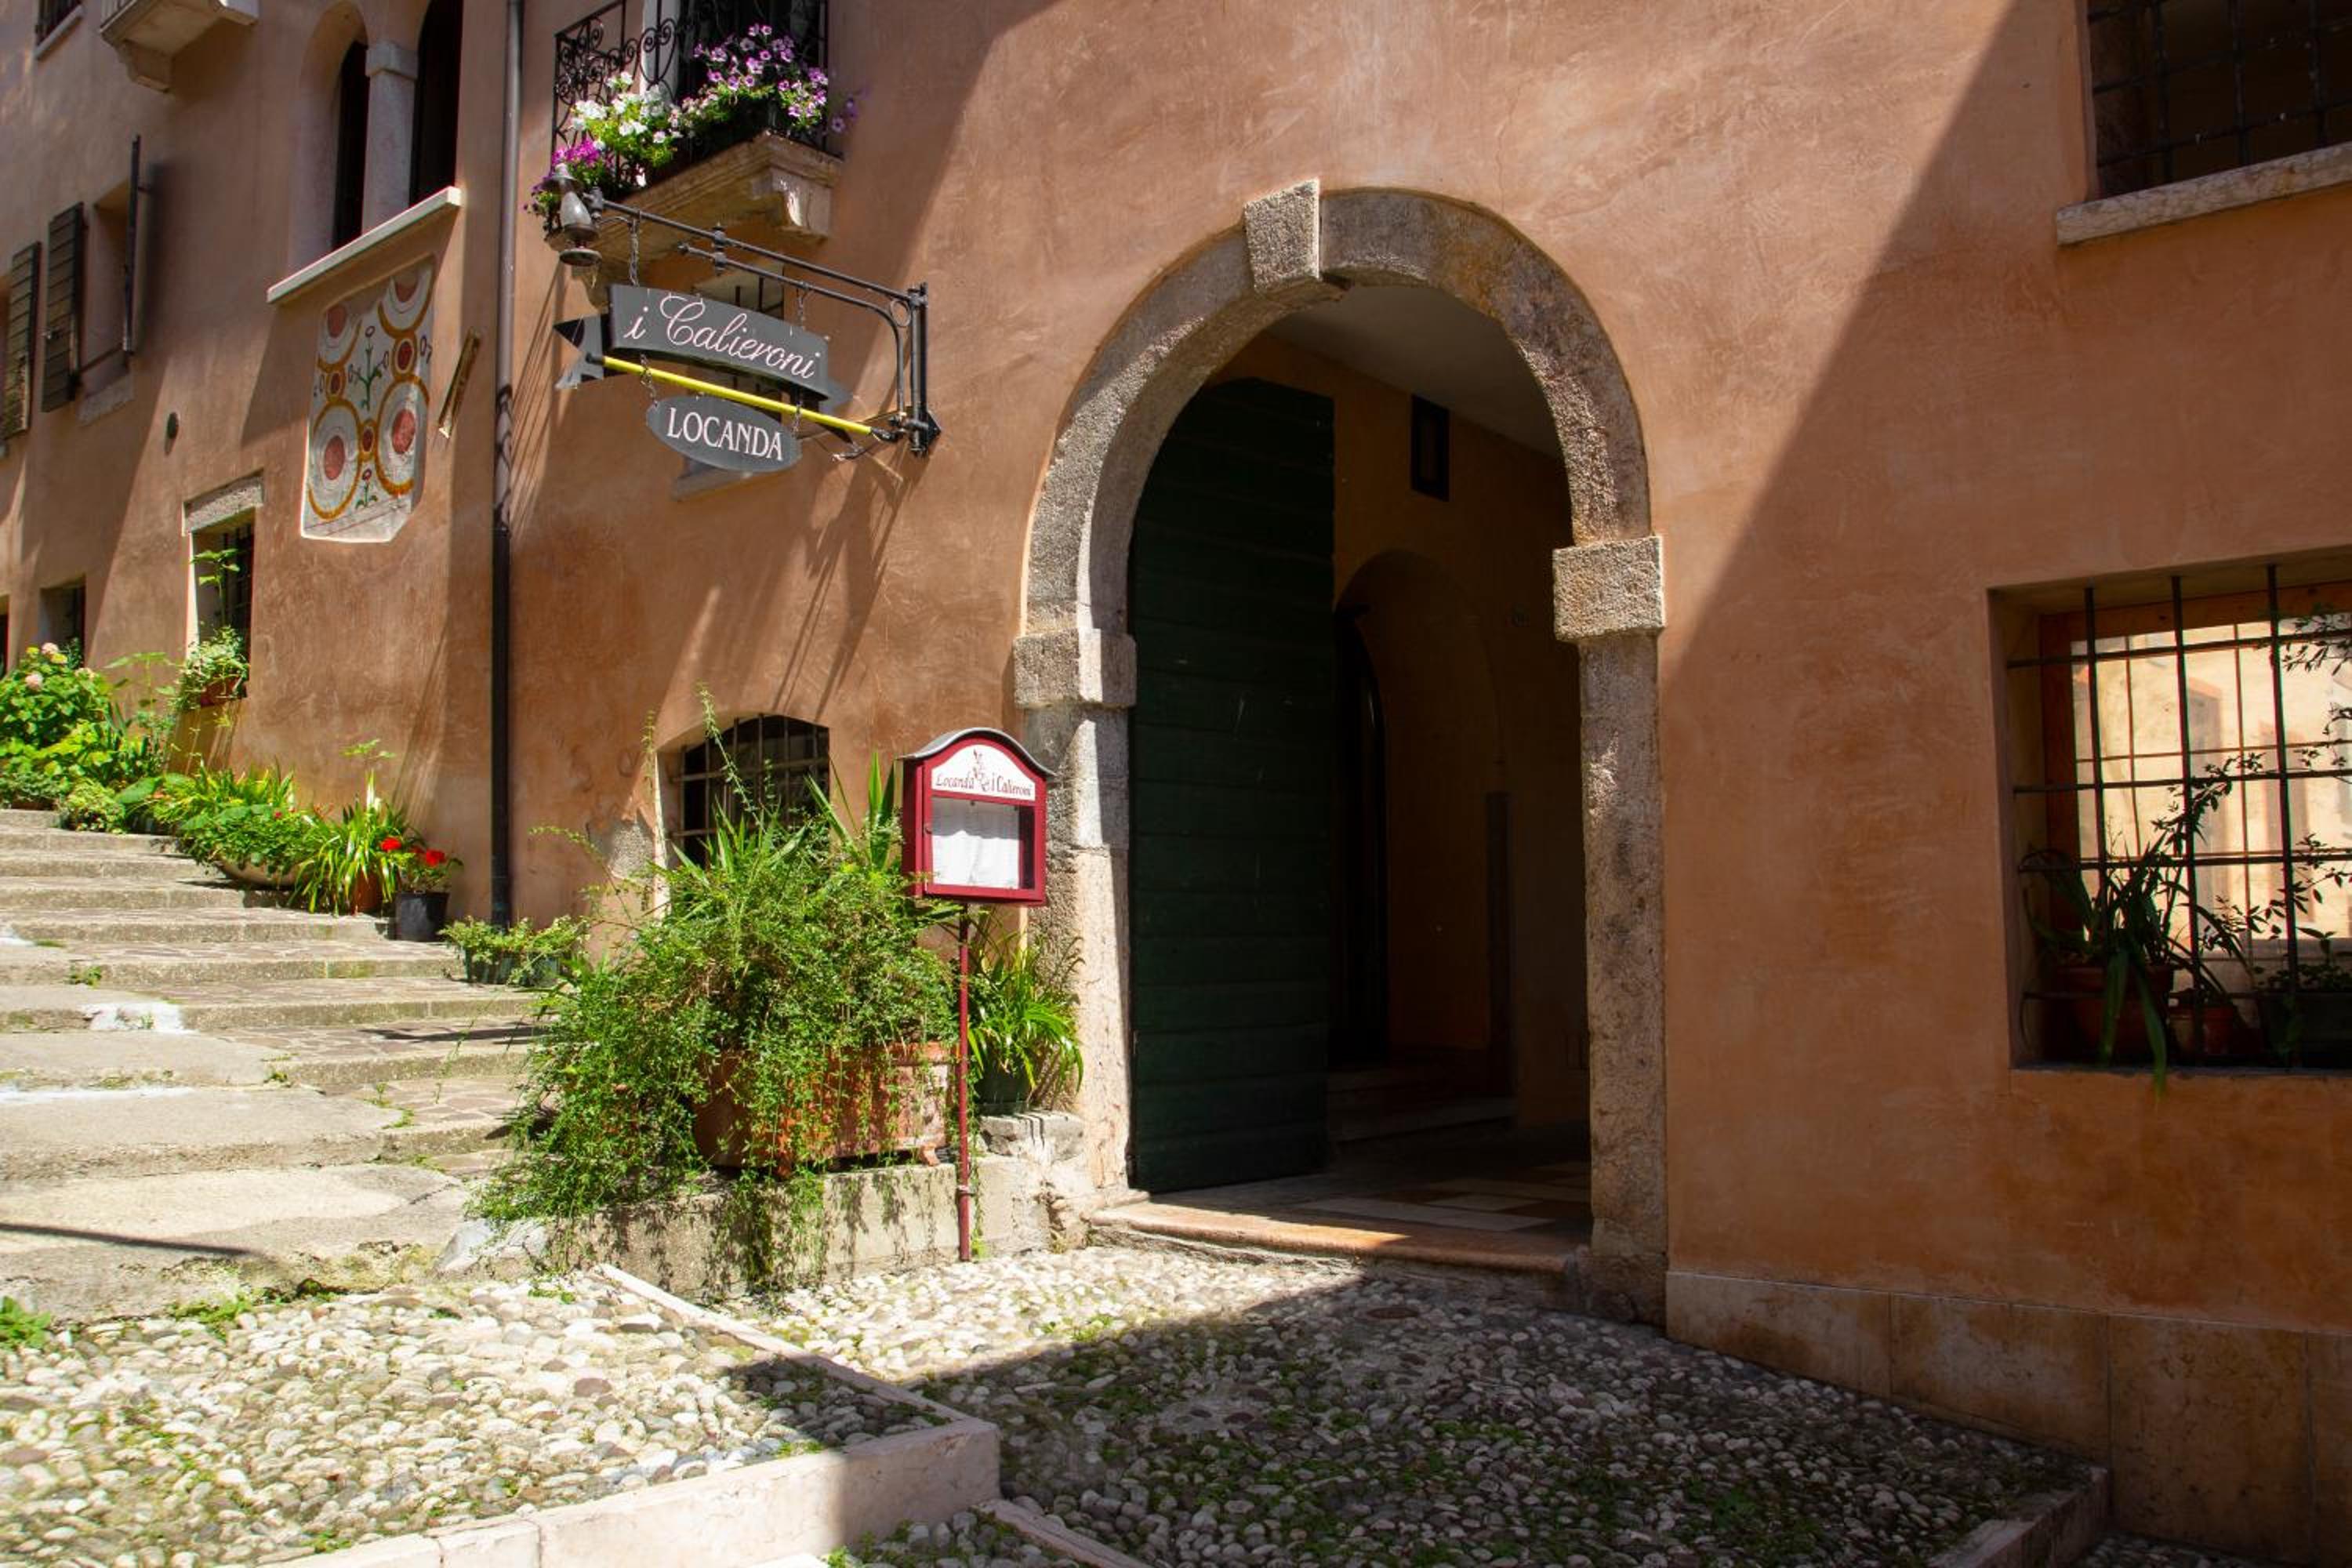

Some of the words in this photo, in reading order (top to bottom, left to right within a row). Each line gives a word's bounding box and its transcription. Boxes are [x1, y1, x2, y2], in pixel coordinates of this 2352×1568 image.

[624, 307, 649, 340] i
[660, 291, 822, 379] Calieroni
[666, 407, 783, 461] LOCANDA
[935, 771, 975, 789] Locanda
